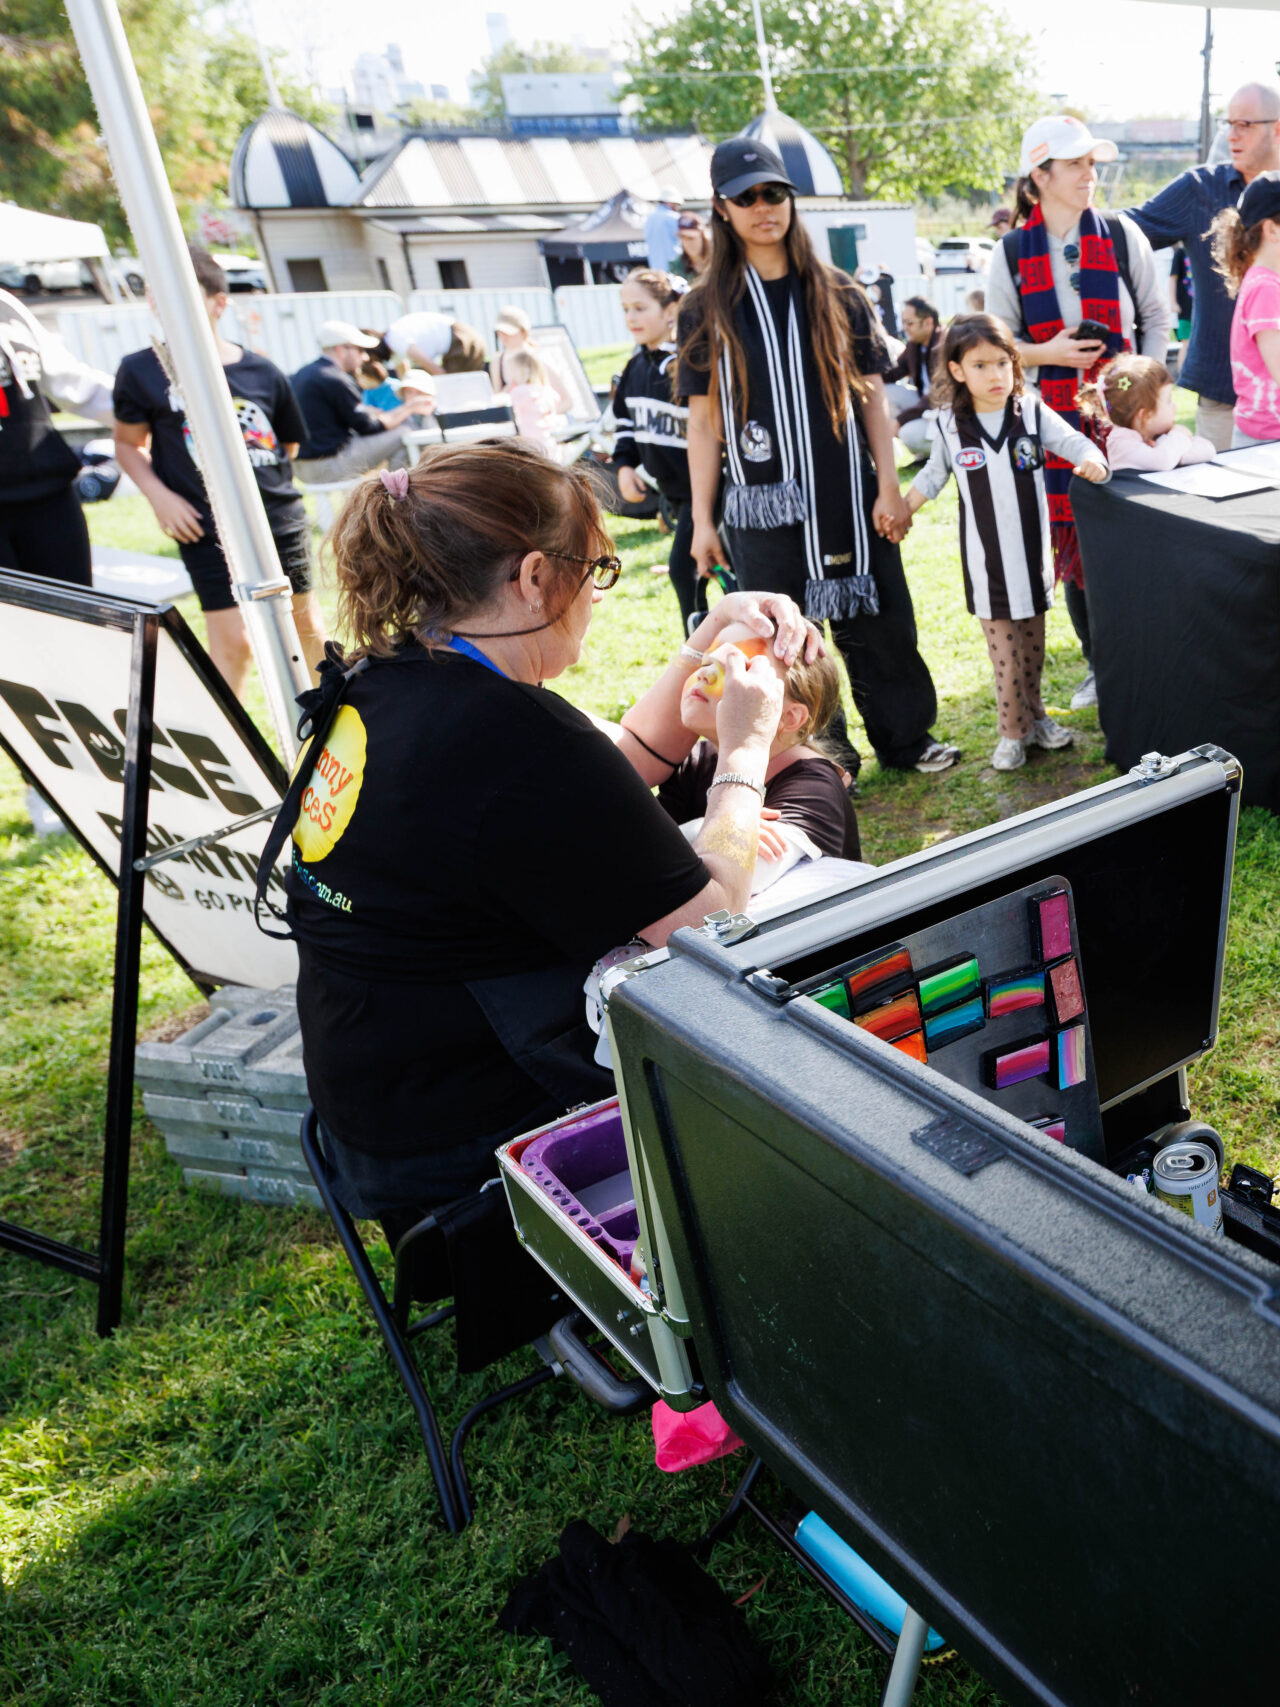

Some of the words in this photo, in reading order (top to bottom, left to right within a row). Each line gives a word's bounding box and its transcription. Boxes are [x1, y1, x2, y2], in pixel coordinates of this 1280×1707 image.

[959, 453, 984, 465] AFL
[0, 678, 264, 817] FACE
[315, 746, 354, 797] nny
[301, 785, 337, 832] ces
[96, 811, 289, 892] PAINTIN
[194, 889, 225, 910] GO
